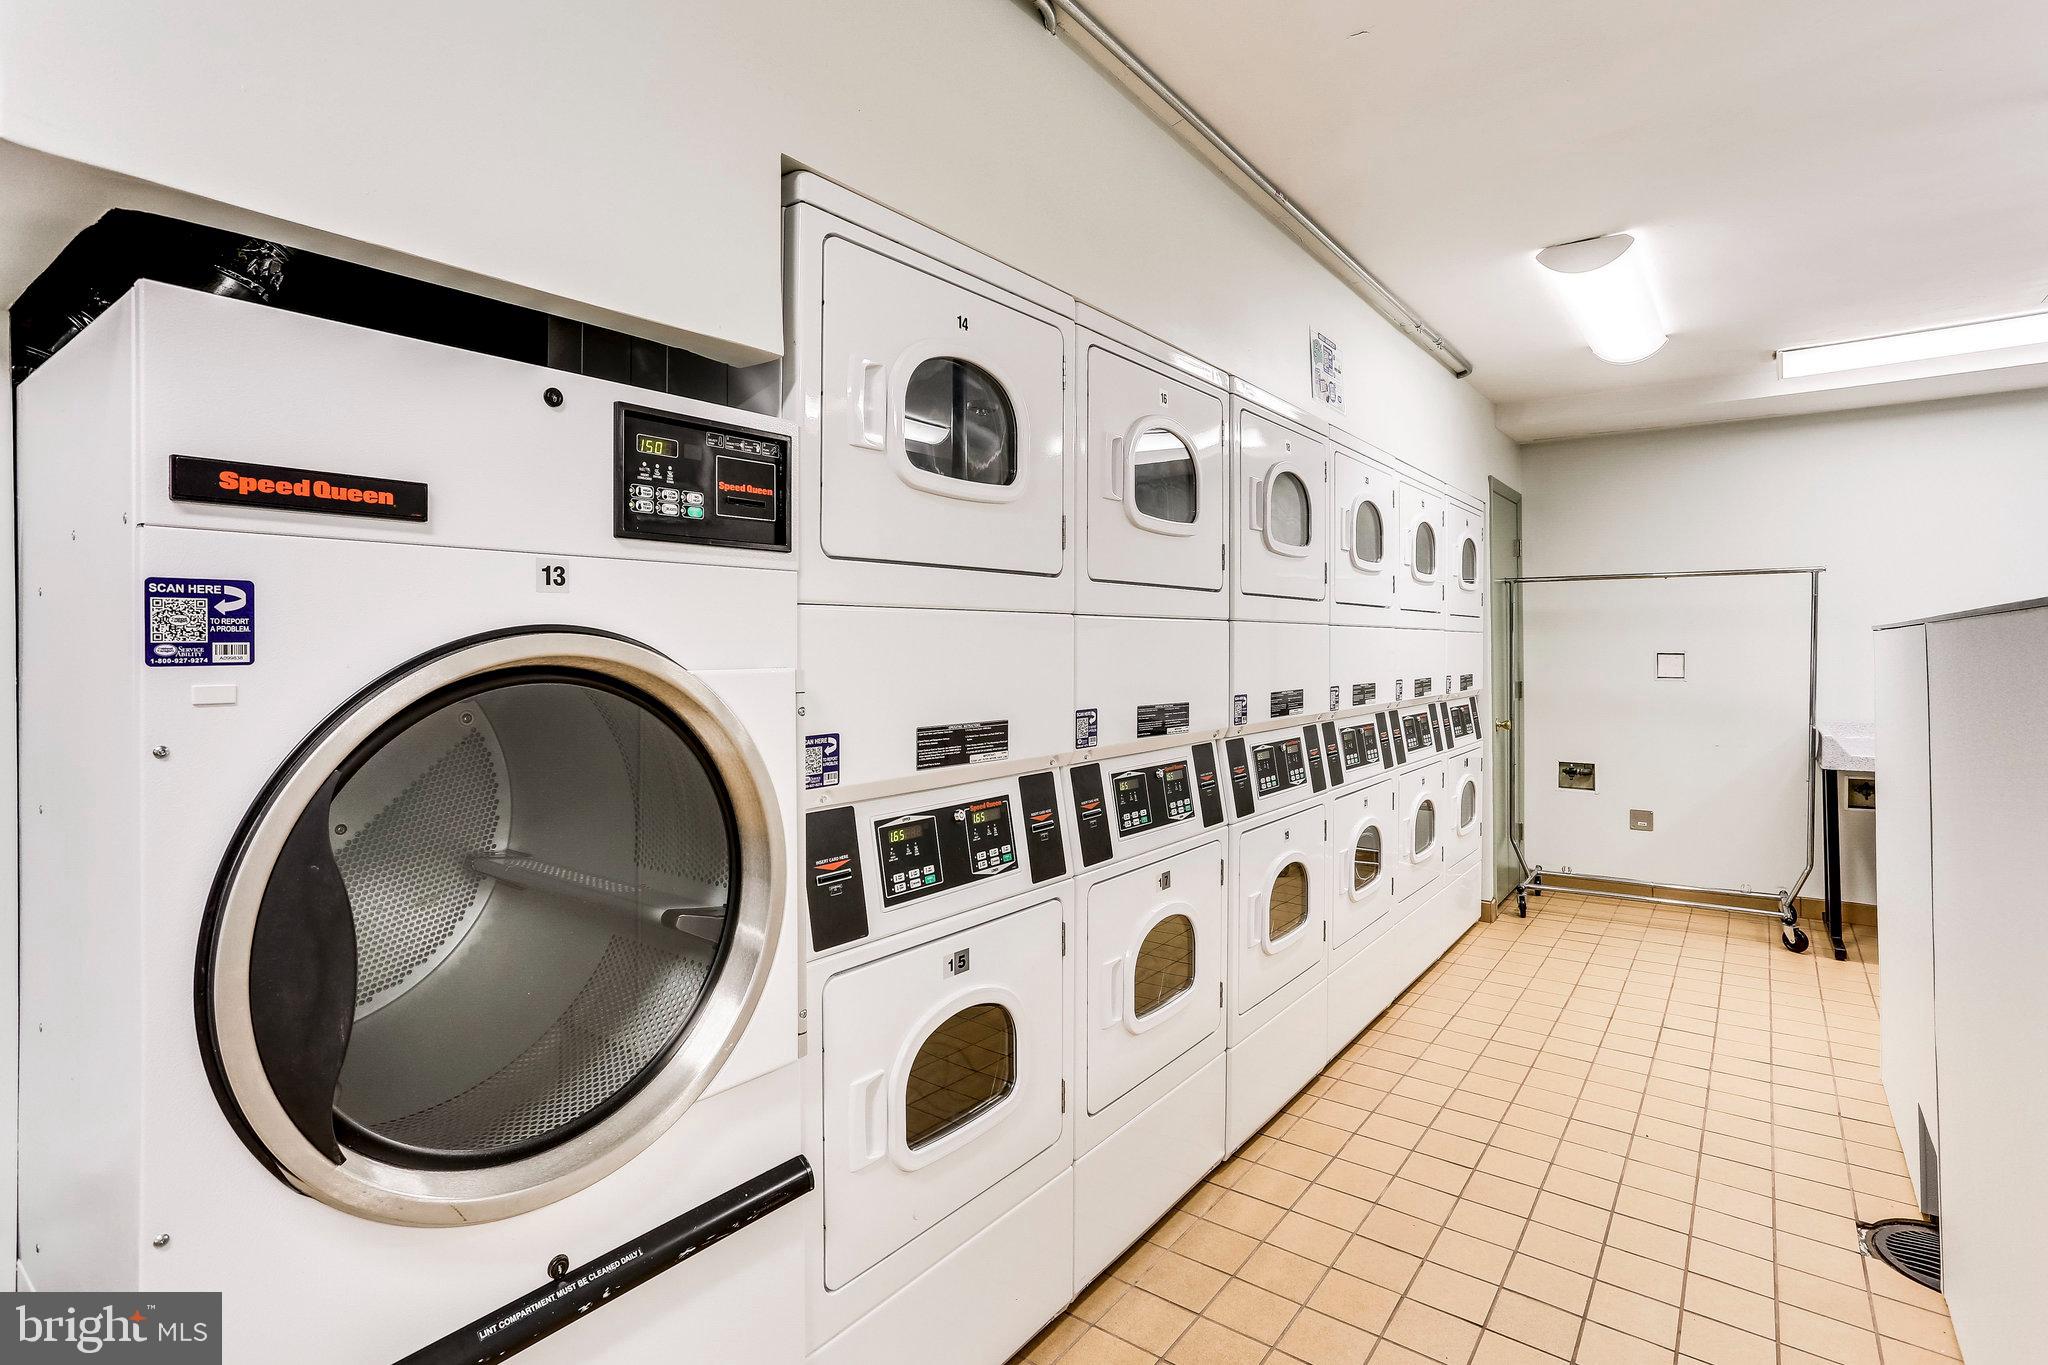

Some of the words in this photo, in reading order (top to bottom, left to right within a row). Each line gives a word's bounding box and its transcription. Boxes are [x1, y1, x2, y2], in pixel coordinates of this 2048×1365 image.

[957, 315, 968, 331] 14
[1160, 392, 1168, 405] 16
[218, 470, 311, 495] Speed
[312, 480, 394, 506] Queen
[718, 481, 746, 492] Speed
[746, 484, 773, 496] Queen
[541, 565, 566, 587] 13
[148, 583, 185, 593] SCAN
[187, 584, 222, 595] HERE
[210, 617, 220, 625] TO
[220, 617, 250, 626] REPORT
[970, 803, 986, 812] Speed
[986, 800, 1002, 808] Queen
[816, 858, 829, 866] INSERT
[1158, 875, 1169, 888] 17
[948, 954, 966, 972] 15
[479, 1324, 498, 1340] LINT
[498, 1293, 556, 1330] COMPARTMENT
[556, 1282, 577, 1298] MUST
[577, 1276, 590, 1288] BE
[588, 1260, 621, 1281] CLEANED
